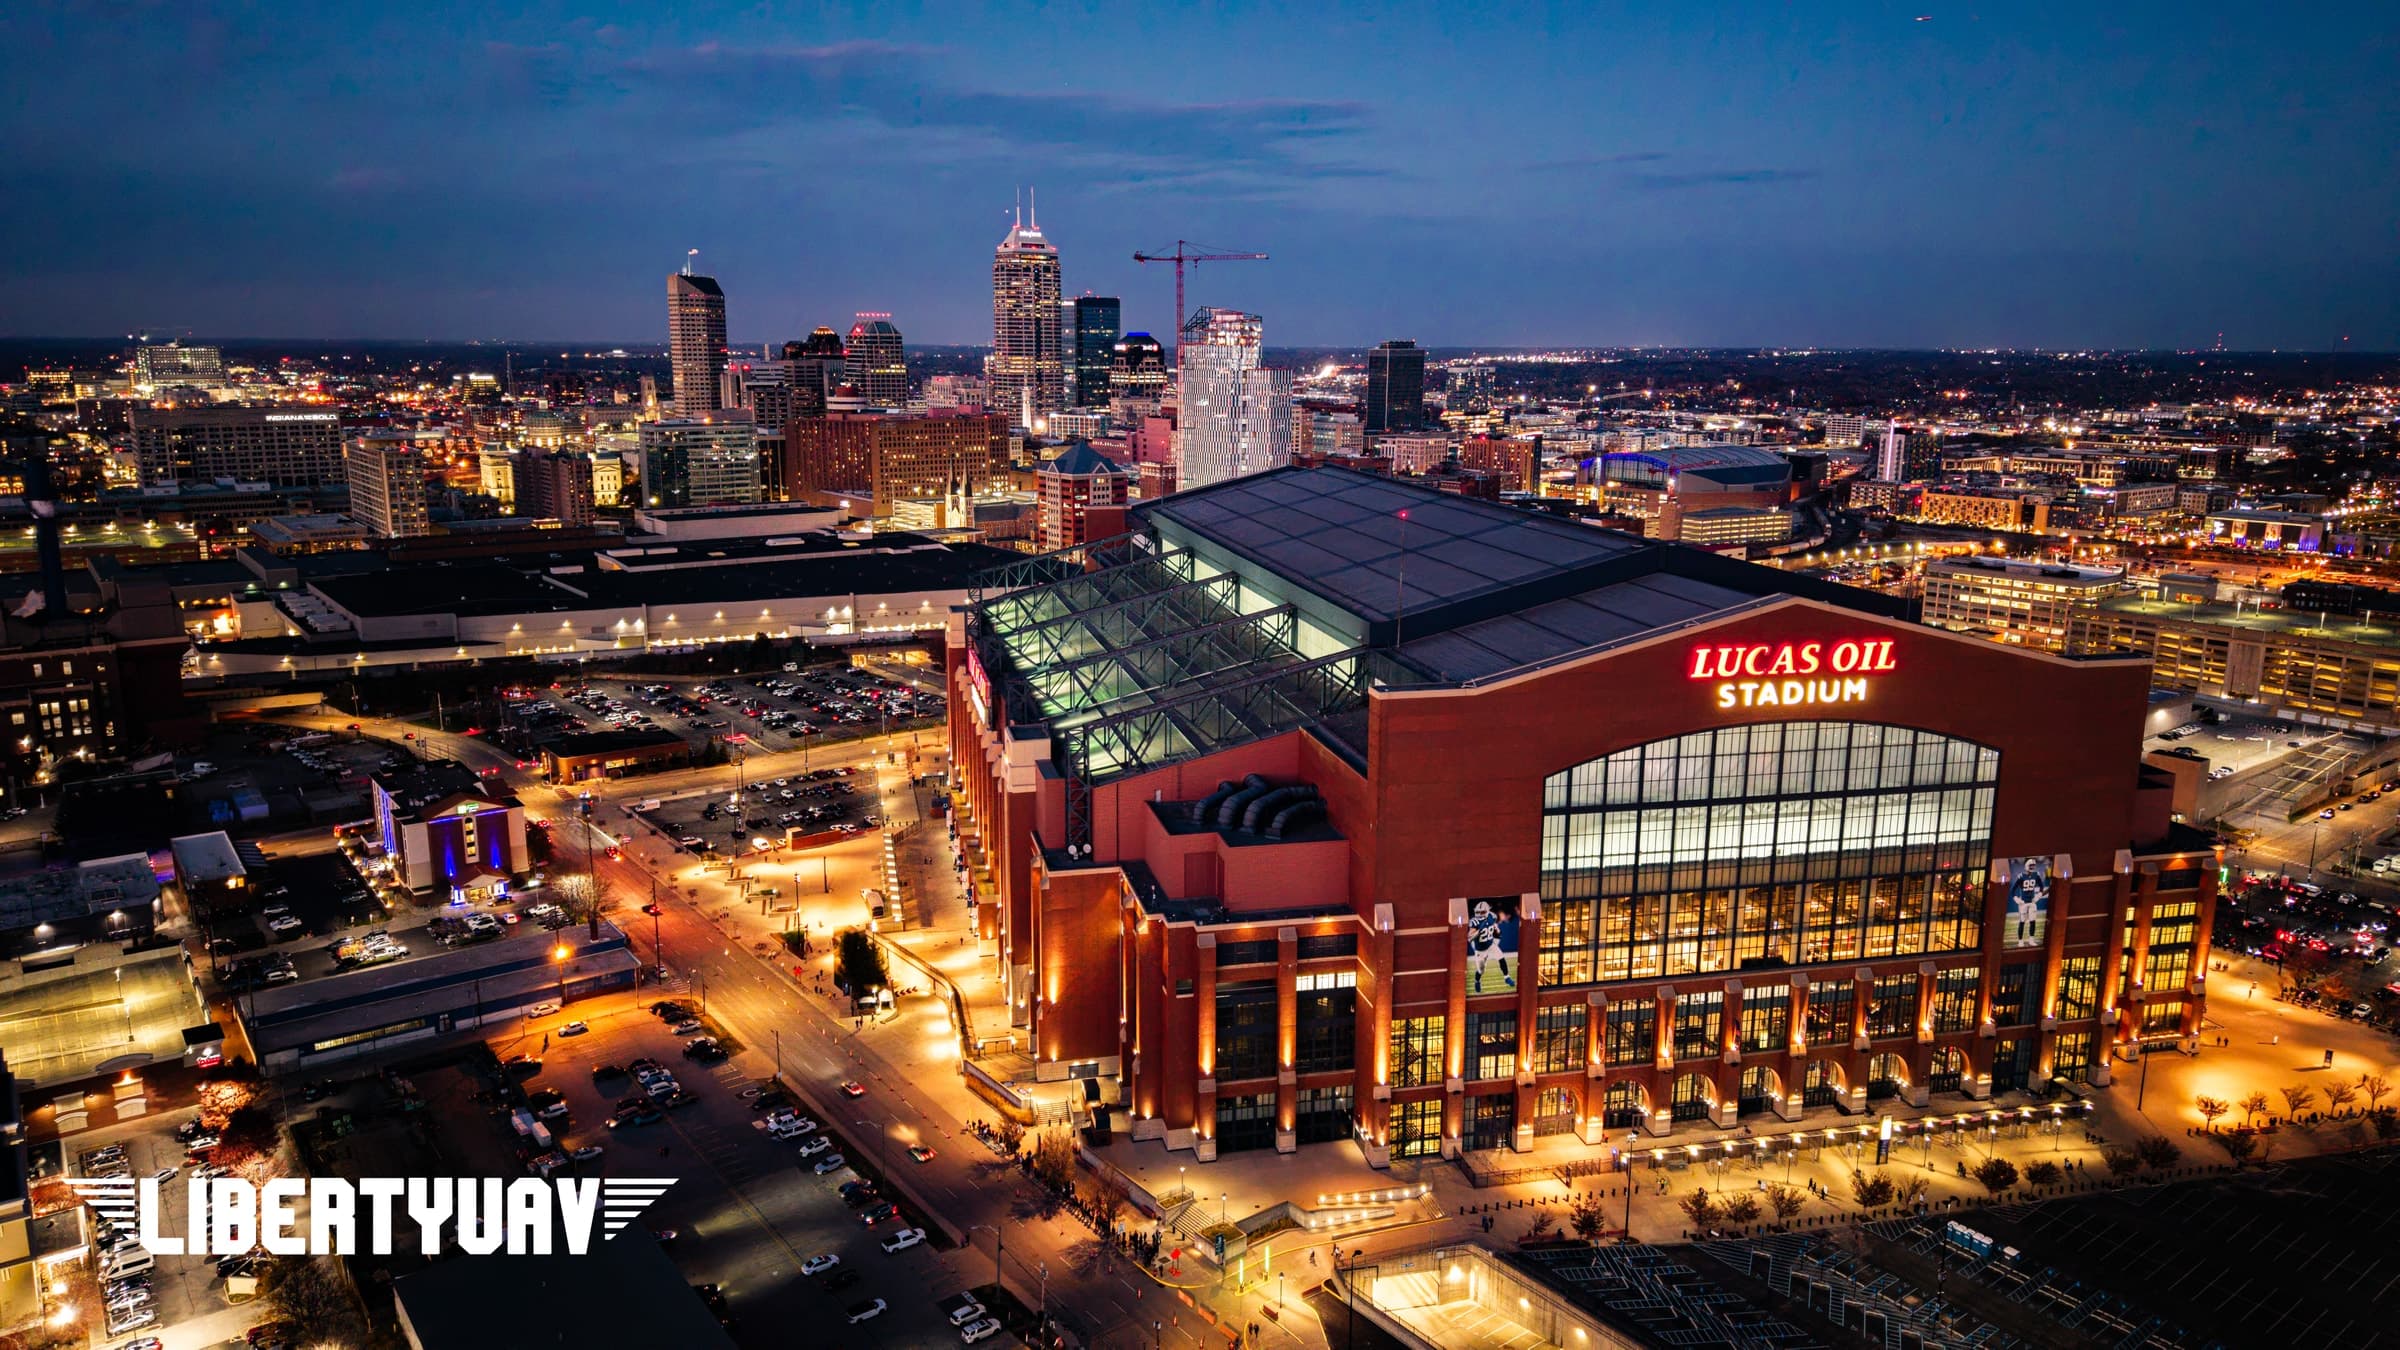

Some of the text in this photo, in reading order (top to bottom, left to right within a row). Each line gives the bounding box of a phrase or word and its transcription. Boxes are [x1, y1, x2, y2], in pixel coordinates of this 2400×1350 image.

[1691, 641, 1896, 678] LUCAS OIL
[1718, 678, 1867, 708] STADIUM
[2023, 880, 2036, 892] 99
[1480, 926, 1495, 943] 28
